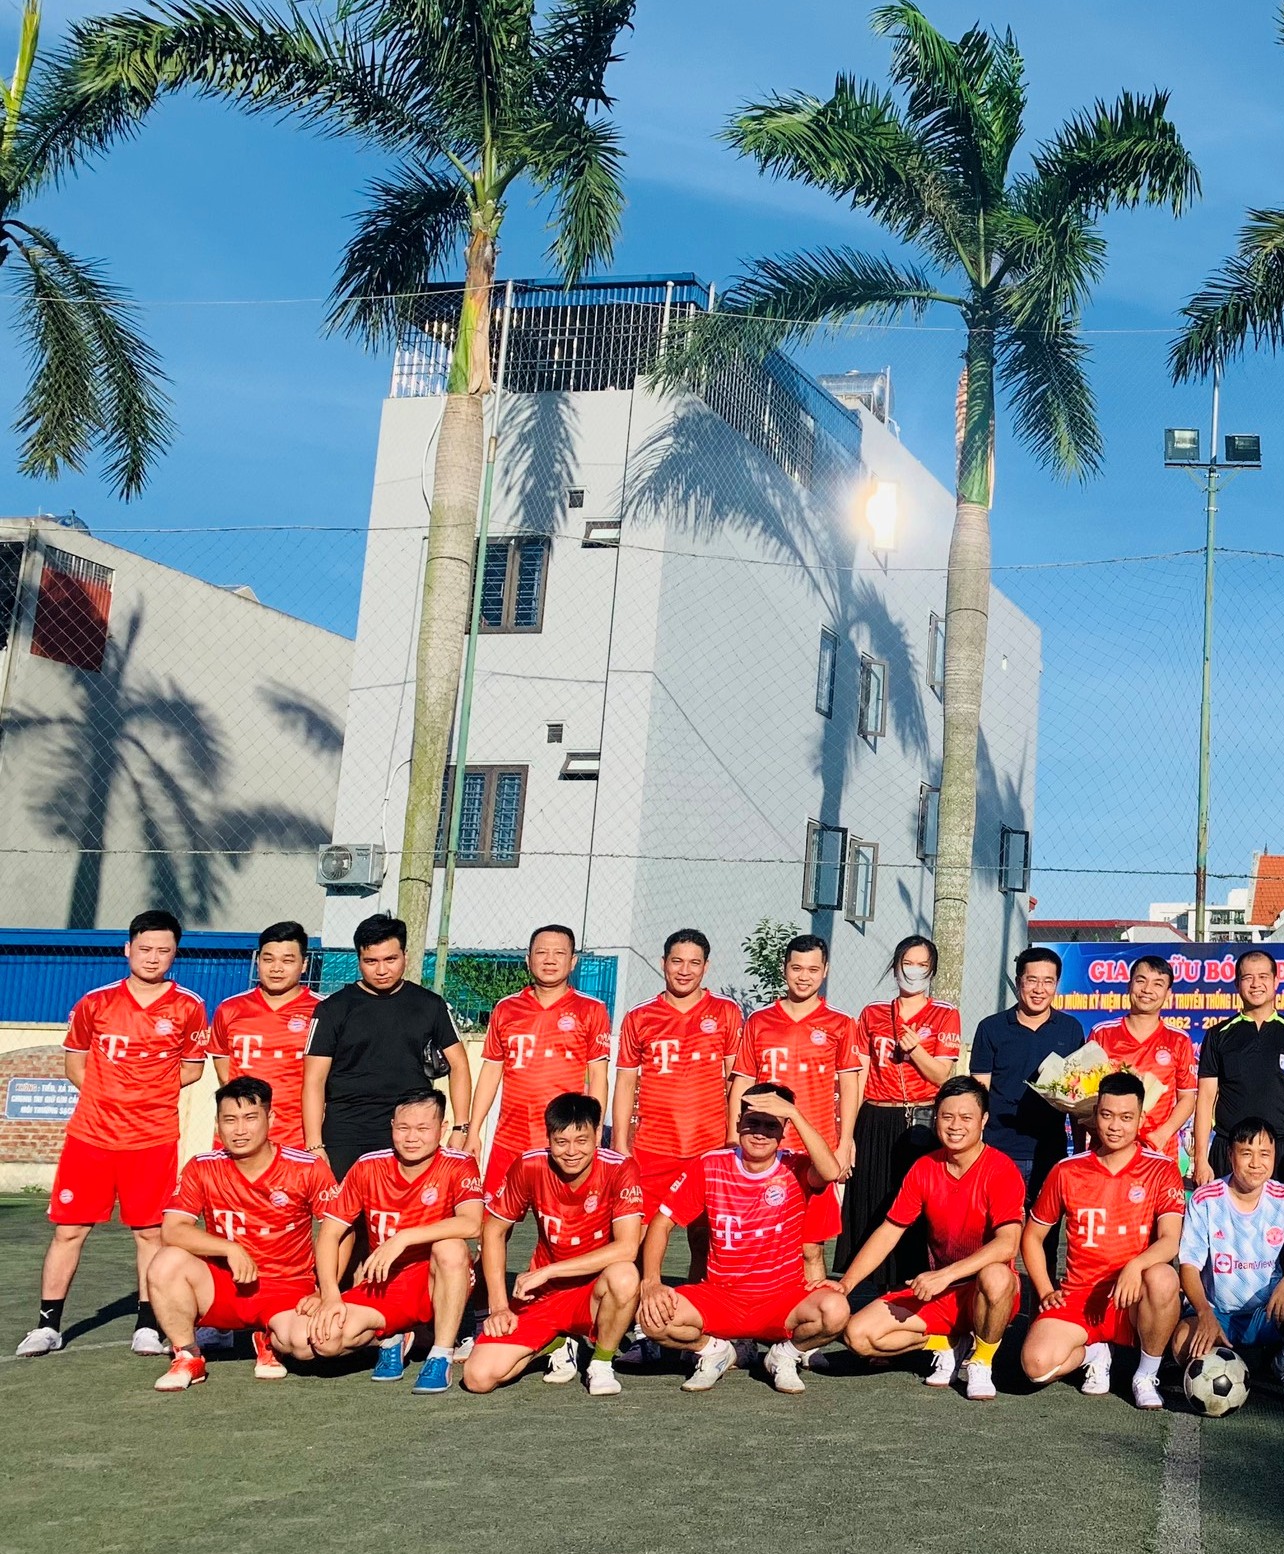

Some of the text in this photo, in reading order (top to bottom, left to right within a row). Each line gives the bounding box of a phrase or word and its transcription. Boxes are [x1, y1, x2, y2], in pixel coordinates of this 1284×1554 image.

[1089, 960, 1130, 982] GIA
[1204, 955, 1237, 982] BÓ
[1100, 989, 1121, 1012] NIỆM
[1175, 988, 1204, 1010] TRUYỀN
[1205, 988, 1232, 1010] THỐNG
[232, 1034, 263, 1069] T
[508, 1034, 536, 1069] T
[650, 1039, 680, 1074] T
[762, 1047, 788, 1083] T
[716, 1214, 742, 1250] T
[1077, 1208, 1107, 1248] T
